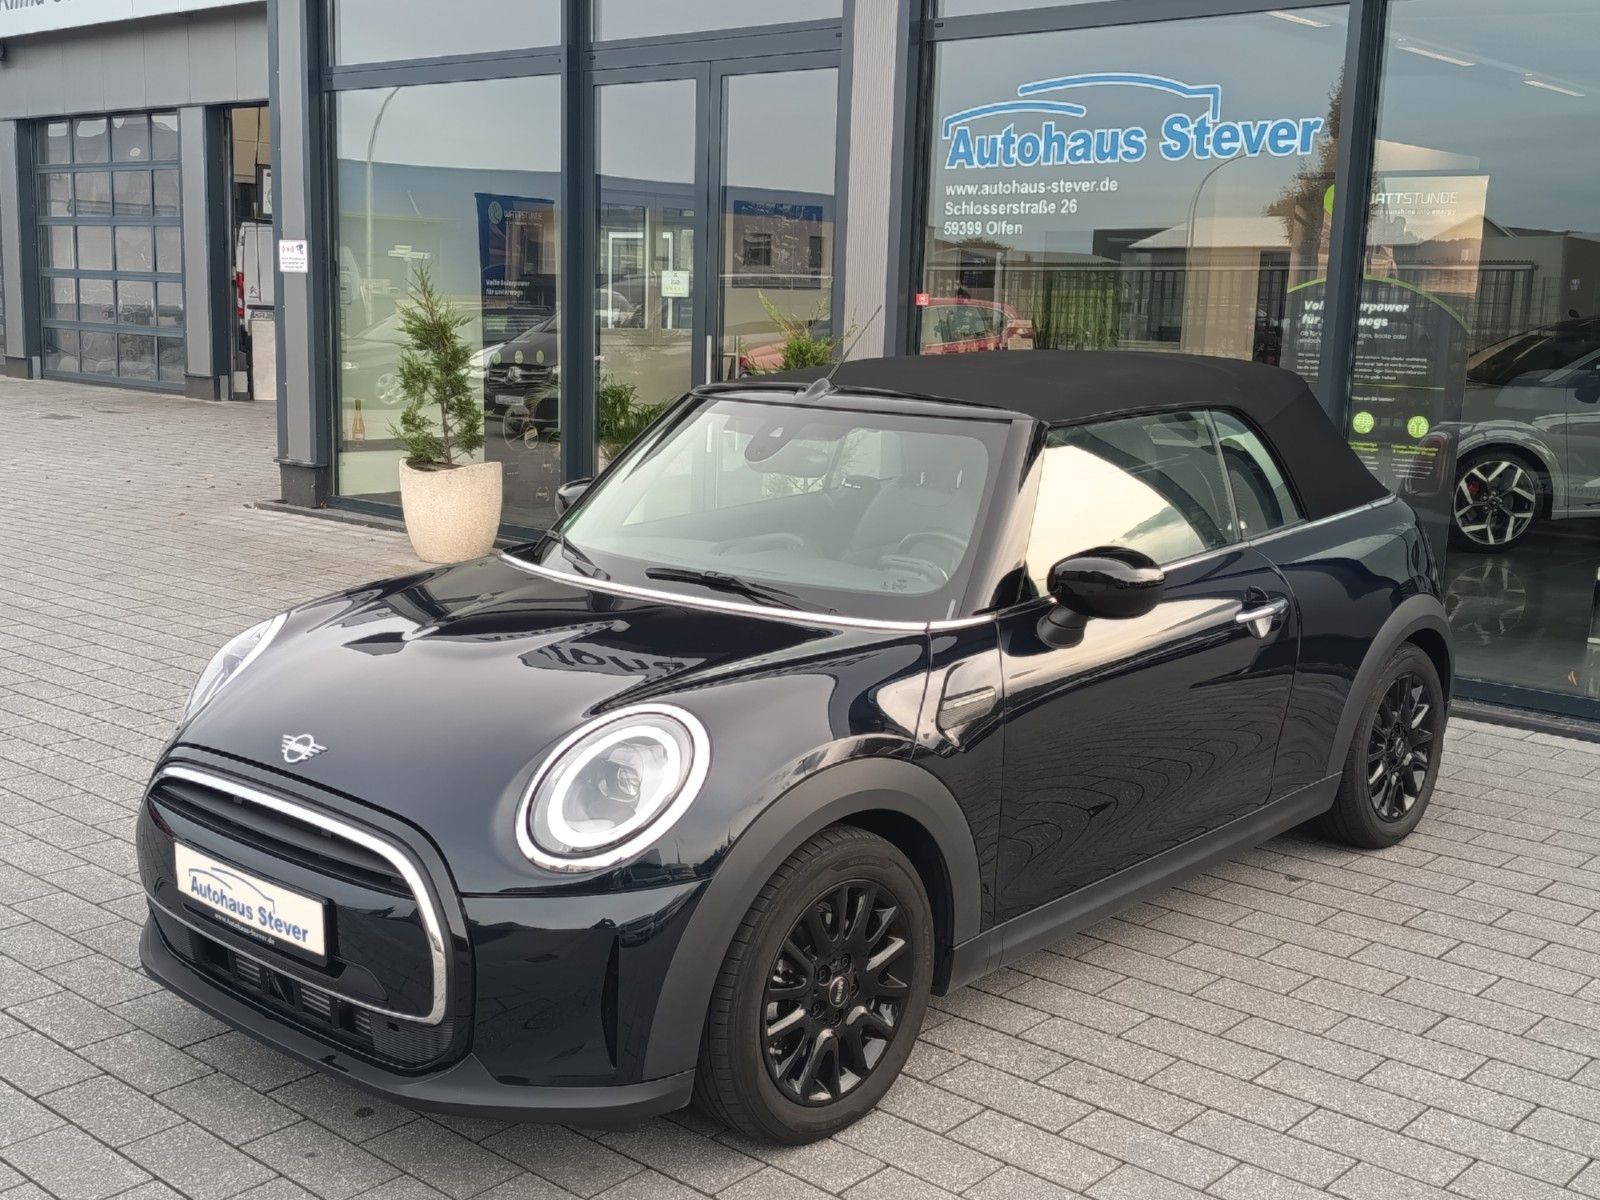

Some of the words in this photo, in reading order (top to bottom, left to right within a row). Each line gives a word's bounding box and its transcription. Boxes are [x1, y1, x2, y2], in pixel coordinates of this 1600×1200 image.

[945, 121, 1147, 169] Autohaus
[1159, 113, 1324, 161] Stever
[945, 177, 1118, 196] www.autohaus-stever.de
[944, 199, 1056, 216] Schlosserstraße
[1060, 199, 1078, 214] 26
[943, 221, 982, 235] 59399
[986, 220, 1023, 235] Olfen
[191, 876, 253, 920] Autohaus
[258, 906, 308, 942] Stever
